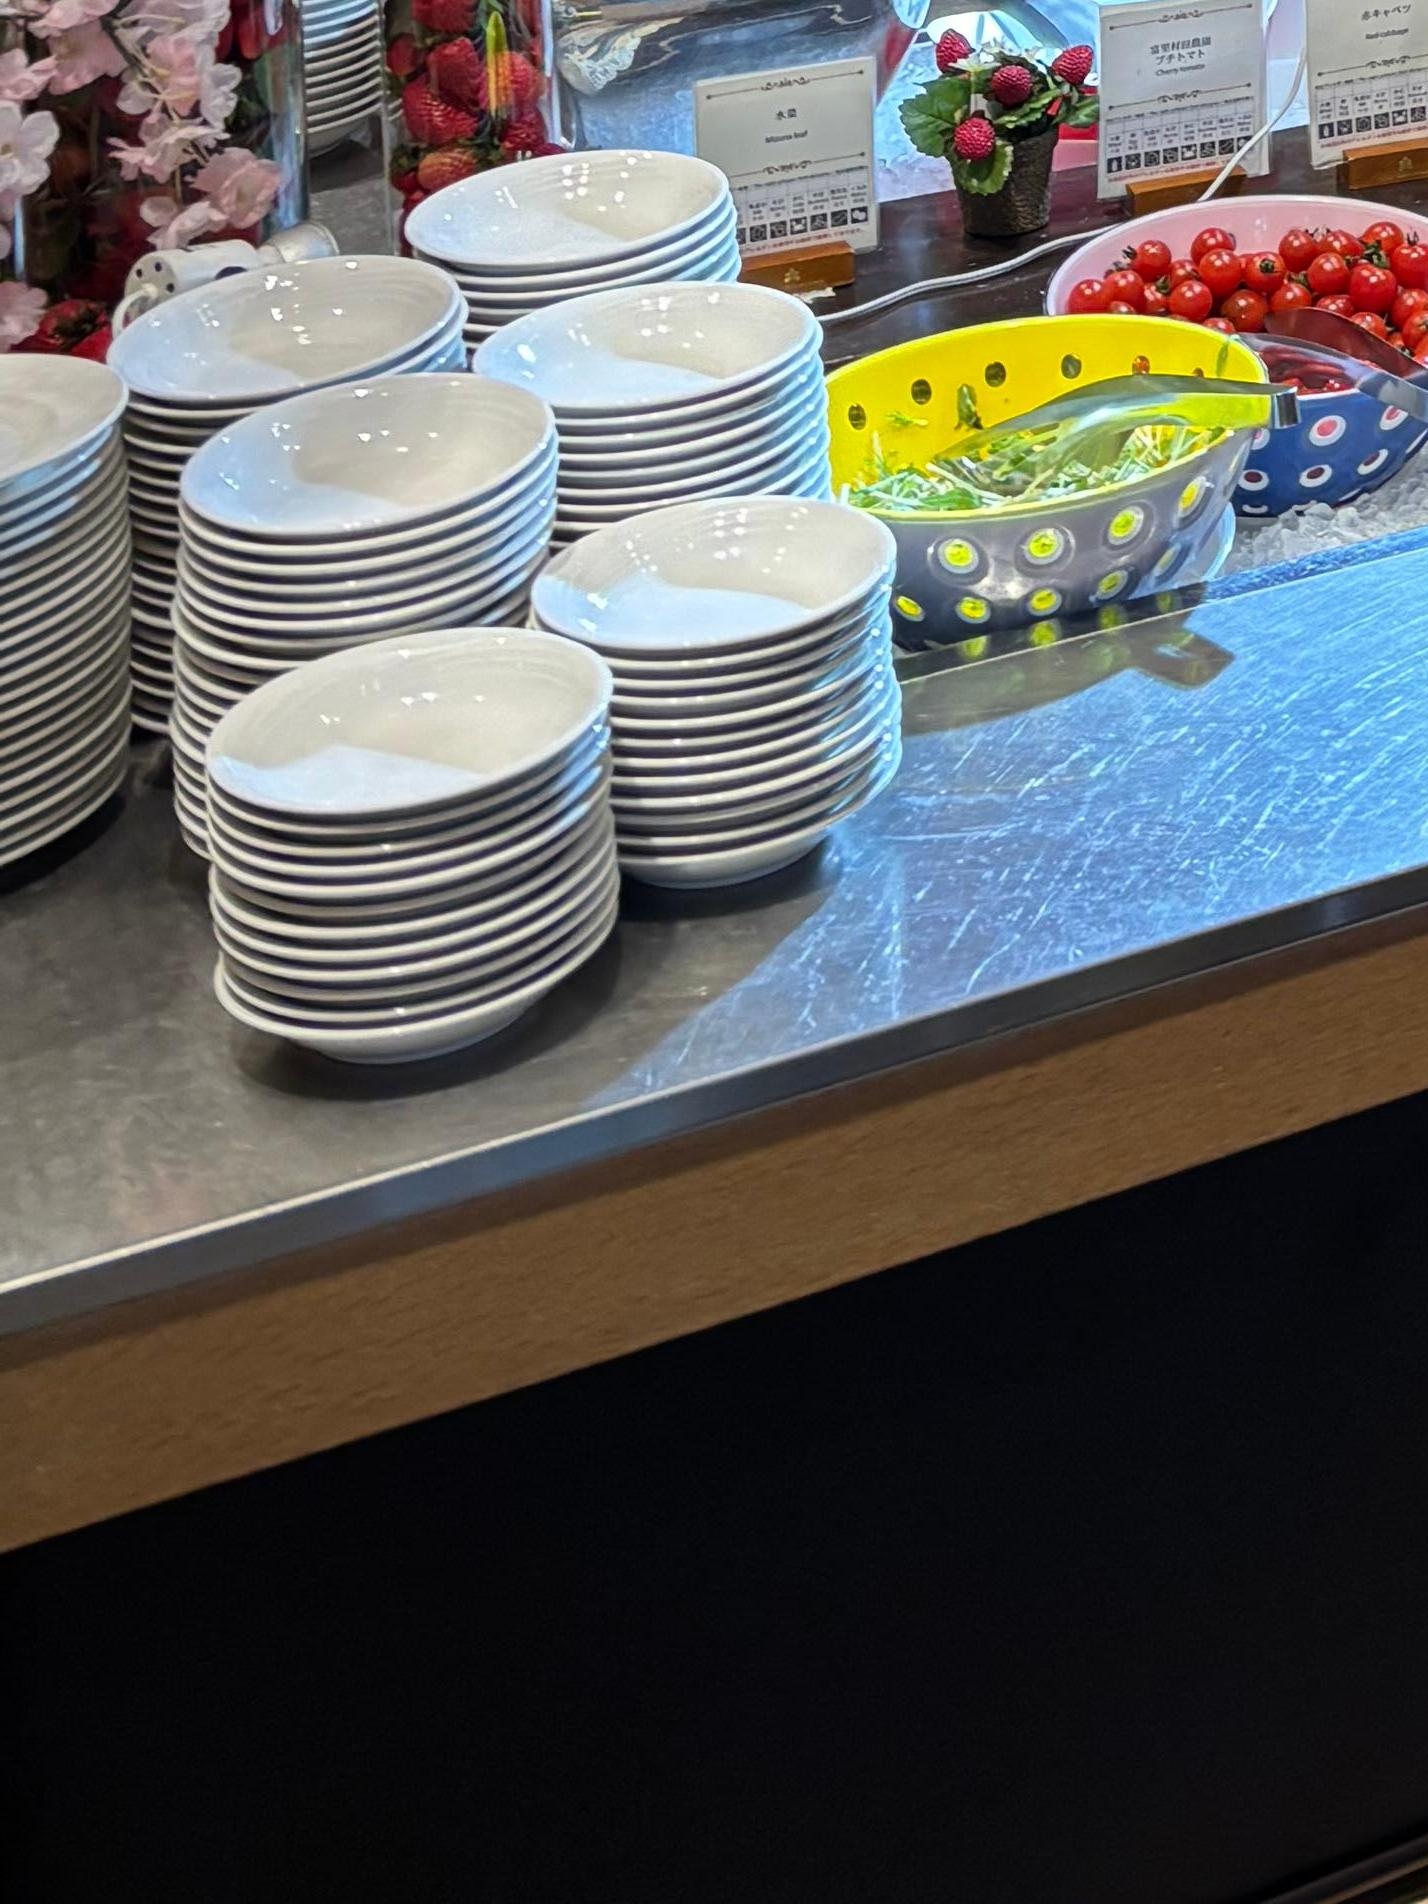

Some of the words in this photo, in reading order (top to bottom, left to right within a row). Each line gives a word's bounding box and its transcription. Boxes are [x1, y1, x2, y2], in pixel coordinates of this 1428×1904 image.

[1361, 4, 1412, 21] 赤キャベツ
[1155, 49, 1206, 65] プチトマト
